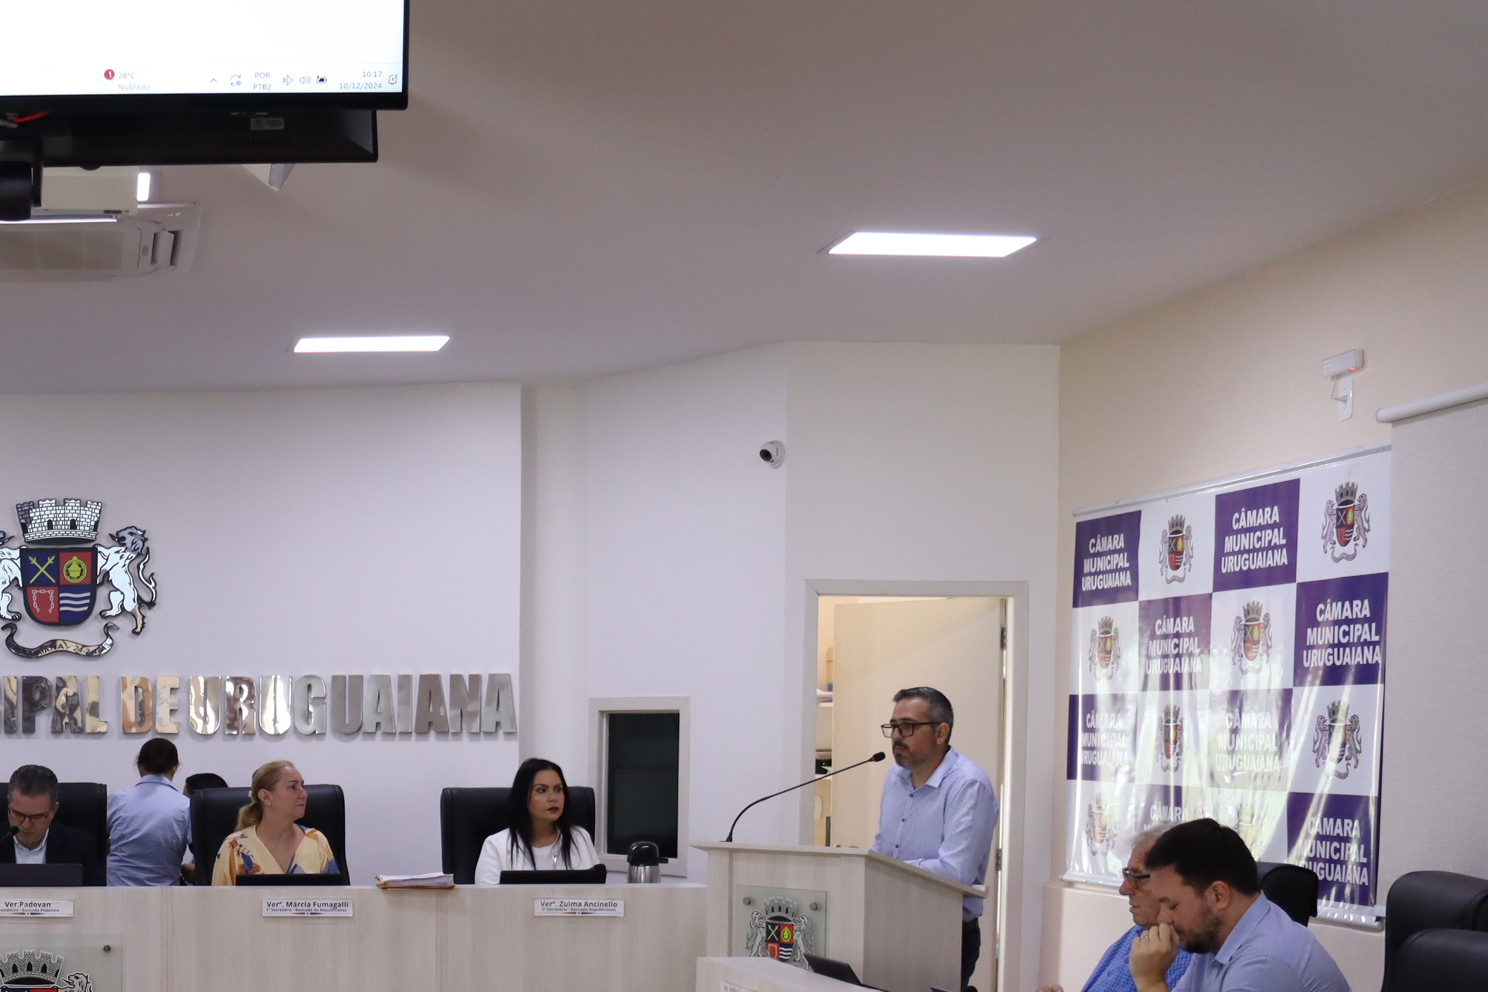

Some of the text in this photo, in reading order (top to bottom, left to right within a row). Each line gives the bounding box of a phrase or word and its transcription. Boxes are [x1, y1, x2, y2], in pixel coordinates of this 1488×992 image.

[253, 83, 272, 91] PTB2
[339, 82, 383, 90] 10/12/2024
[1232, 505, 1279, 530] CÂMARA
[1089, 532, 1125, 553] CÂMARA
[1224, 526, 1287, 553] MUNICIPAL
[1083, 556, 1130, 573] MUNICIPAL
[1221, 548, 1288, 574] URUGUAIANA
[1081, 571, 1132, 591] URUGUAIANA
[1316, 598, 1371, 622] CÂMARA
[1155, 614, 1195, 635] CÂMARA
[1148, 636, 1201, 656] MUNICIPAL
[1306, 625, 1381, 646] MUNICIPAL
[1145, 656, 1202, 674] URUGUAIANA
[1303, 644, 1382, 668] URUGUAIANA
[120, 676, 181, 736] DE
[189, 673, 518, 737] URUGUAIANA
[1225, 708, 1272, 729] CÂMARA
[1217, 733, 1280, 751] MUNICIPAL
[1215, 753, 1281, 772] URUGUAIANA
[313, 901, 349, 910] Fumagalli
